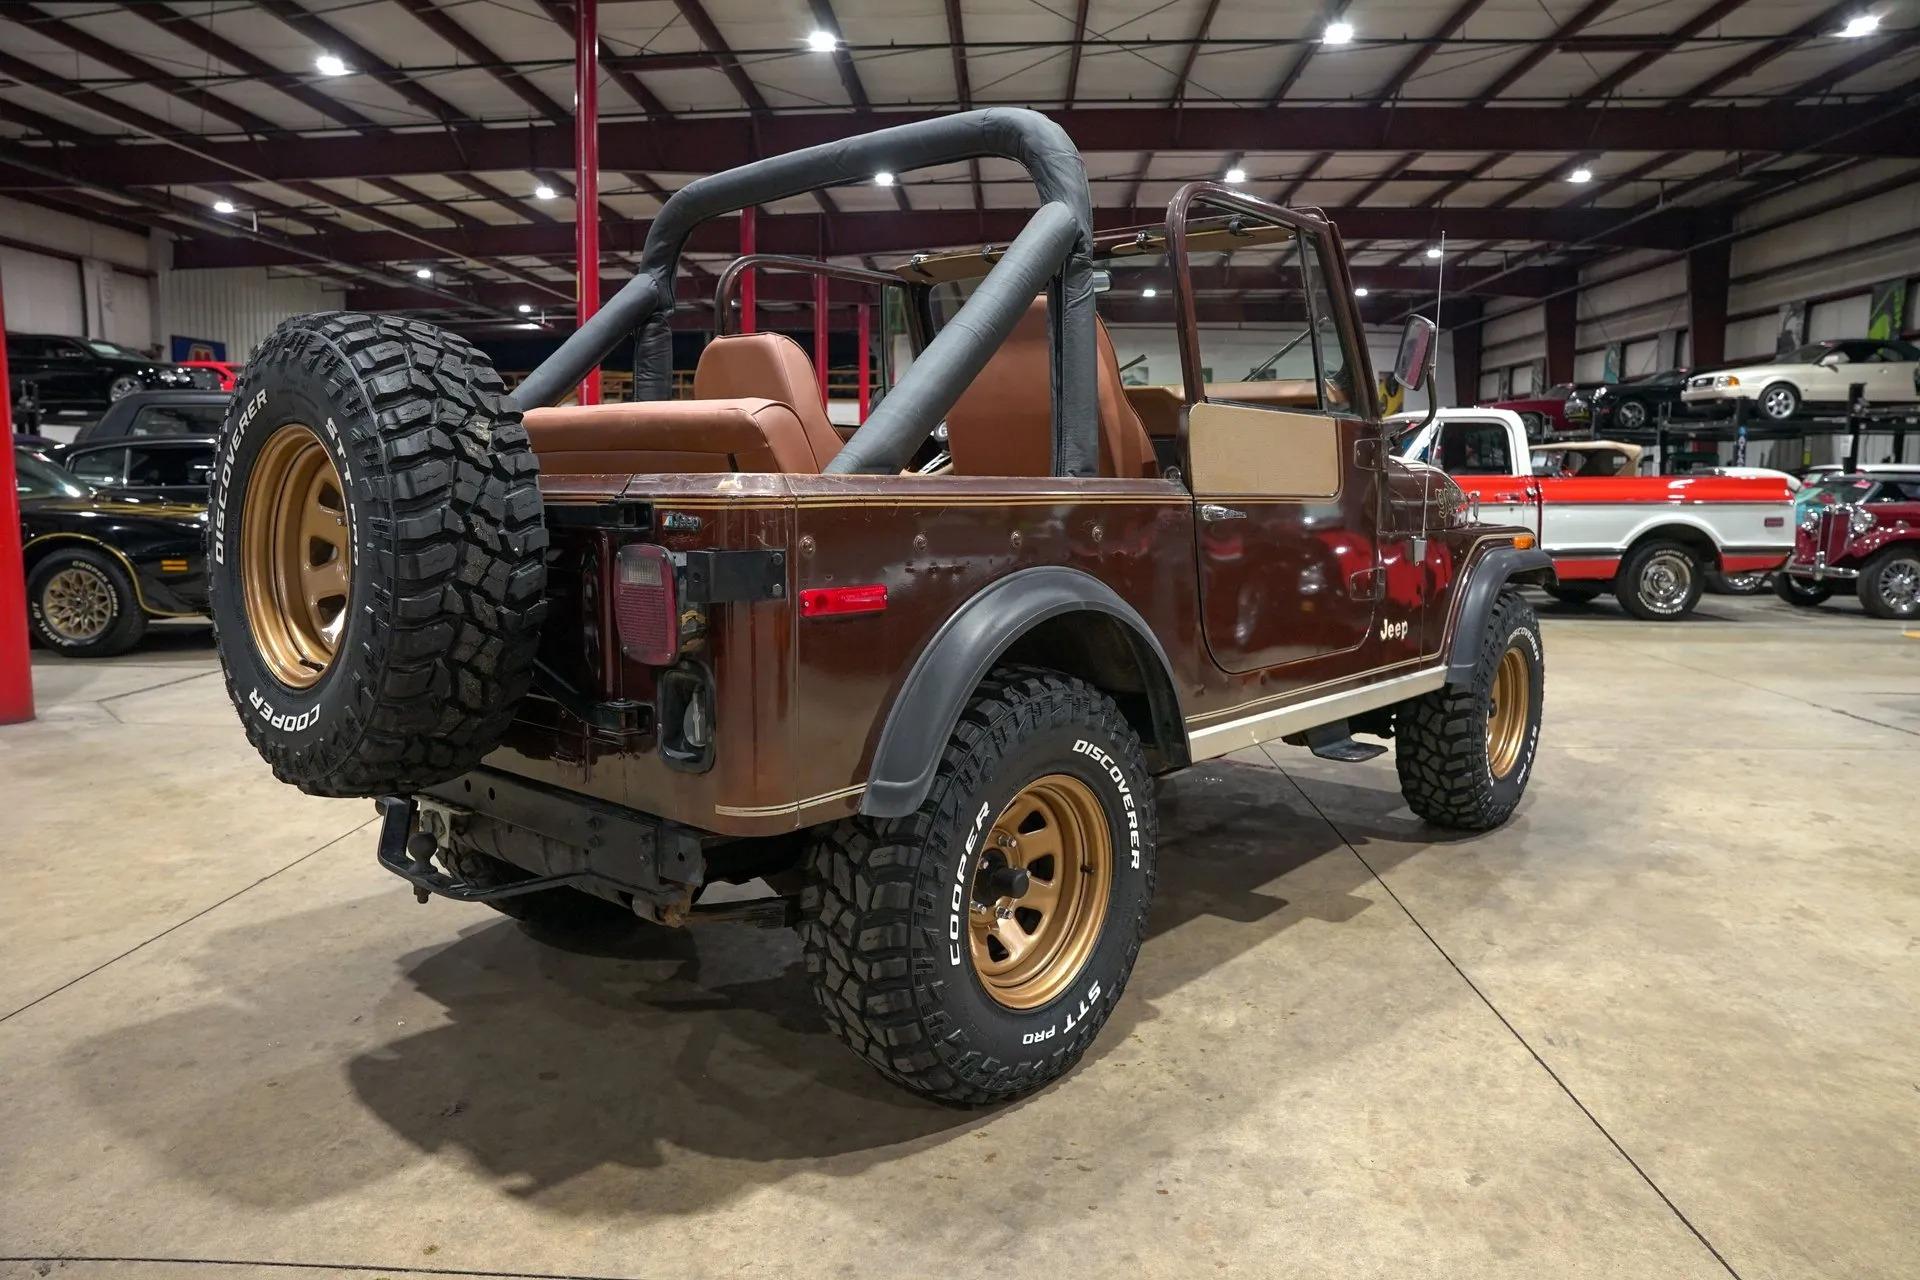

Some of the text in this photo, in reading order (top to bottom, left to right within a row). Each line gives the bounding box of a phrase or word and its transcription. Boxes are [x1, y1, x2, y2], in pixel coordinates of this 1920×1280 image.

[215, 388, 268, 565] DISCOVERER
[325, 417, 353, 487] STT
[1380, 618, 1408, 640] Jeep
[248, 686, 320, 732] COOPER
[1073, 739, 1140, 870] DISCOVERER
[949, 801, 991, 966] COOPER
[1022, 979, 1101, 1045] STT PRO
